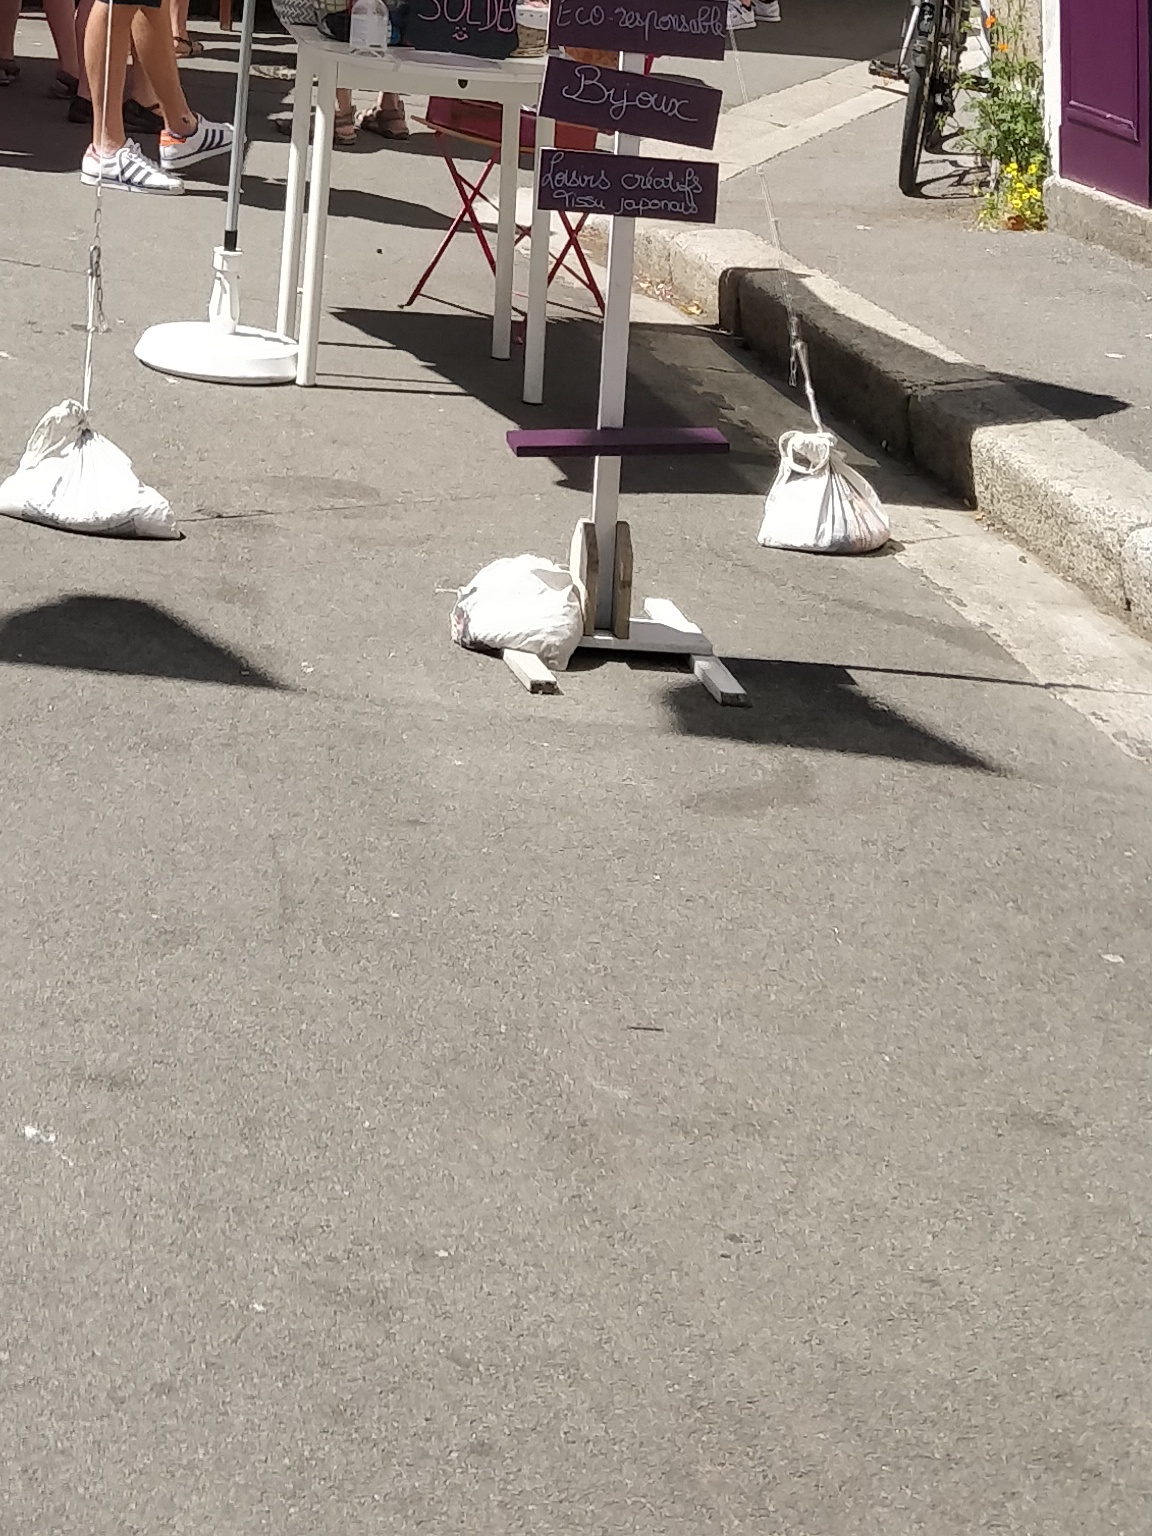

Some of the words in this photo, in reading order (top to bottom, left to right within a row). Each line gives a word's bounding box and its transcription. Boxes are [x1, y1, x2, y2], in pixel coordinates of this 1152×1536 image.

[562, 65, 698, 120] Bijoux
[541, 151, 611, 190] Loisirs
[621, 167, 703, 207] créatifs
[553, 189, 605, 210] Tissu
[615, 196, 698, 215] japonais
